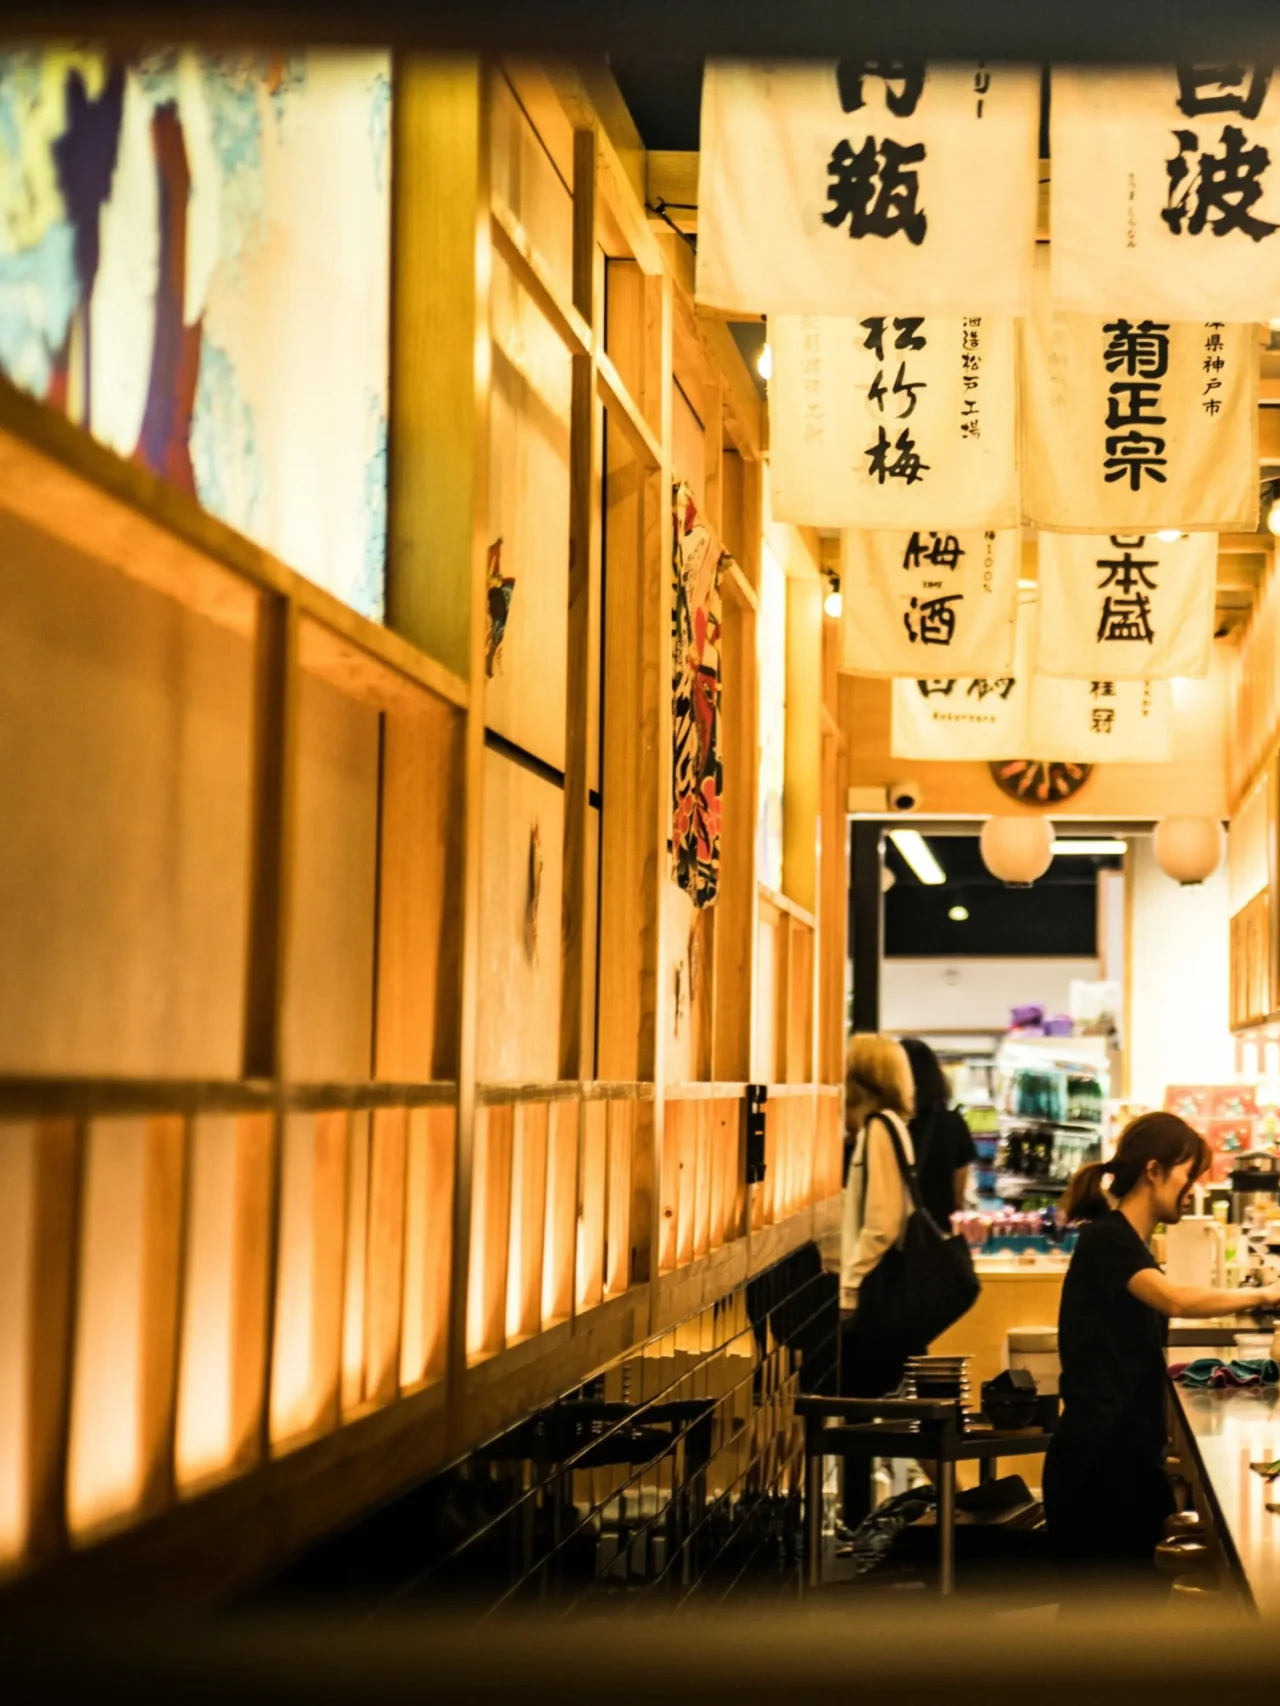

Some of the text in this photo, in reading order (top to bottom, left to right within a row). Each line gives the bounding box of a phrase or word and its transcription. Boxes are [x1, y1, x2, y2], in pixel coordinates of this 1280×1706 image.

[859, 316, 931, 486] 松竹梅
[1102, 318, 1171, 493] 菊正宗
[902, 530, 966, 645] 梅酒
